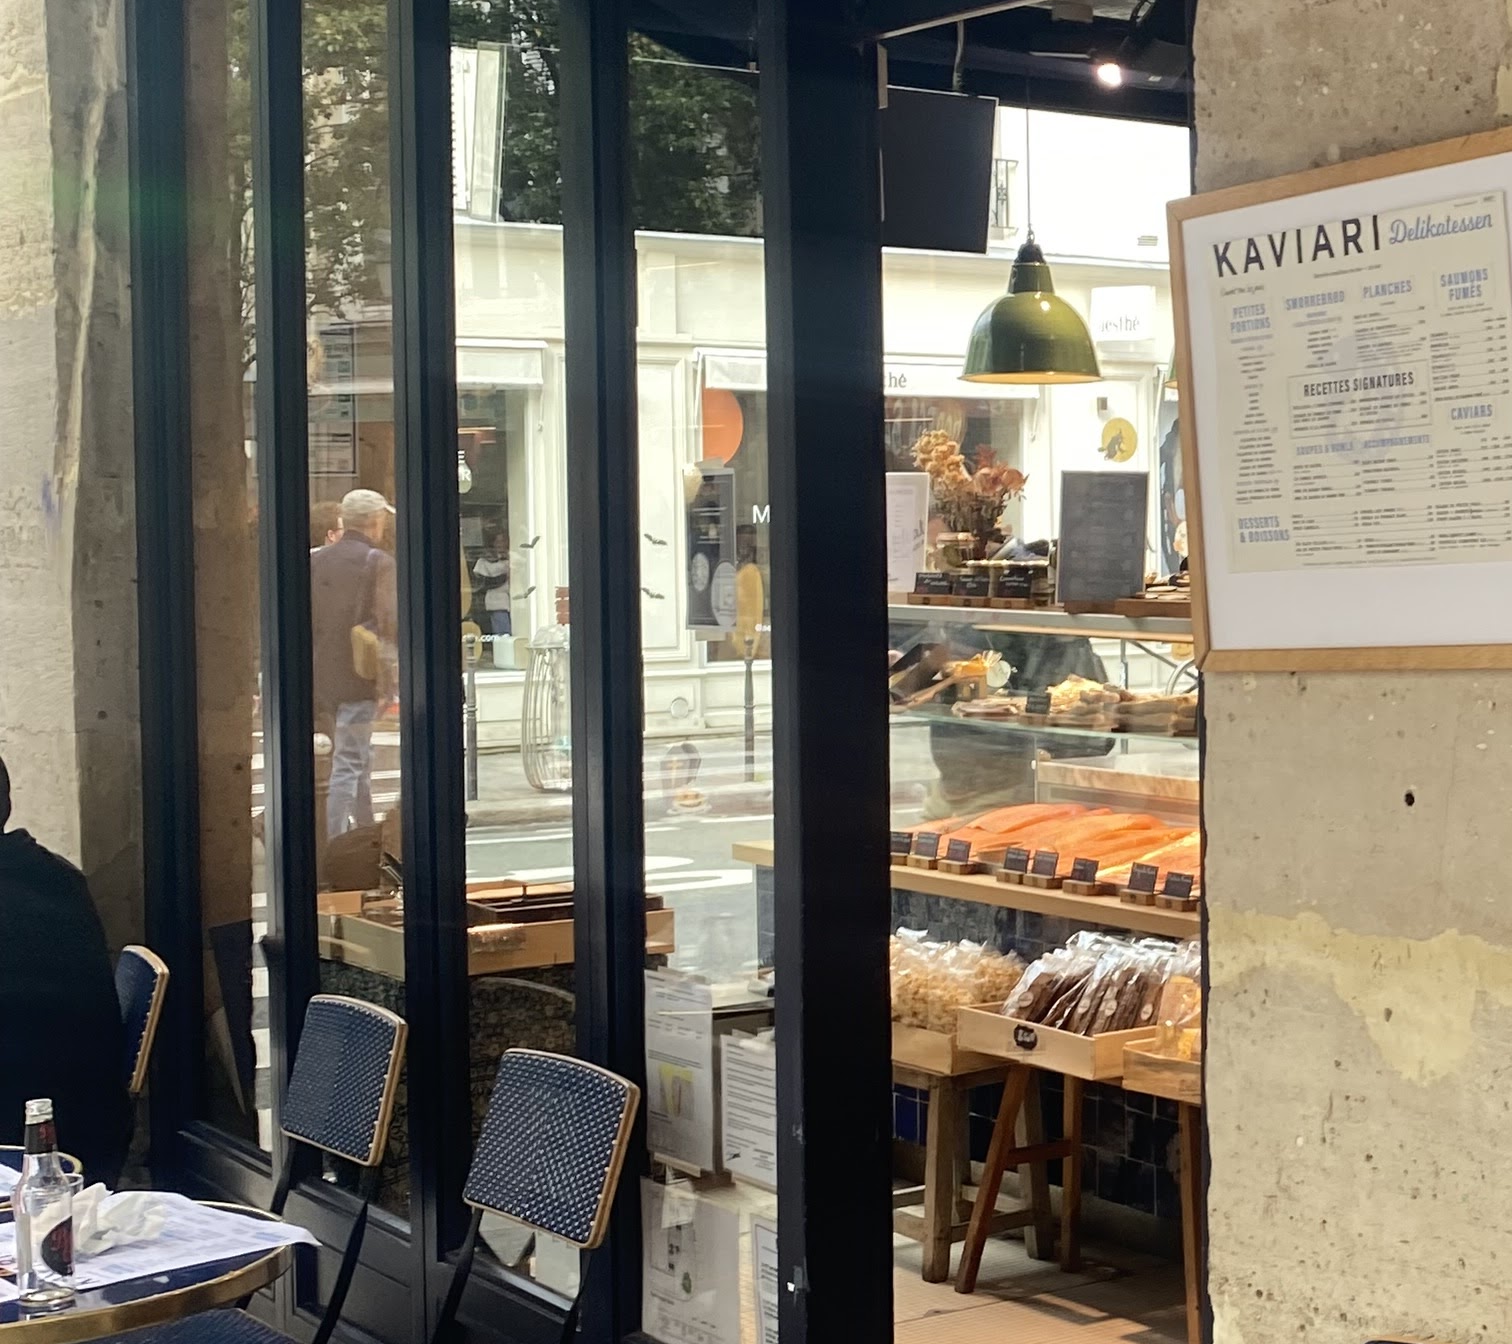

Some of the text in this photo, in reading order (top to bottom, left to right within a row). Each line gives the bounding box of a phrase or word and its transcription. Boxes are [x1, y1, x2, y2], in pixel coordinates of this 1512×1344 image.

[1213, 214, 1493, 278] KAVIARI Delikatessen
[1440, 268, 1489, 287] SAUMONS
[1363, 280, 1413, 298] PLANCHES
[1449, 284, 1482, 301] FUMÉS
[1233, 303, 1266, 320] PETITES
[1230, 317, 1271, 334] PORTIONS
[1304, 371, 1415, 397] RECETTES SIGNATURES
[1451, 404, 1493, 421] CAVIARS
[1238, 515, 1280, 530] DESSERTS
[1249, 529, 1290, 543] BOISSONS
